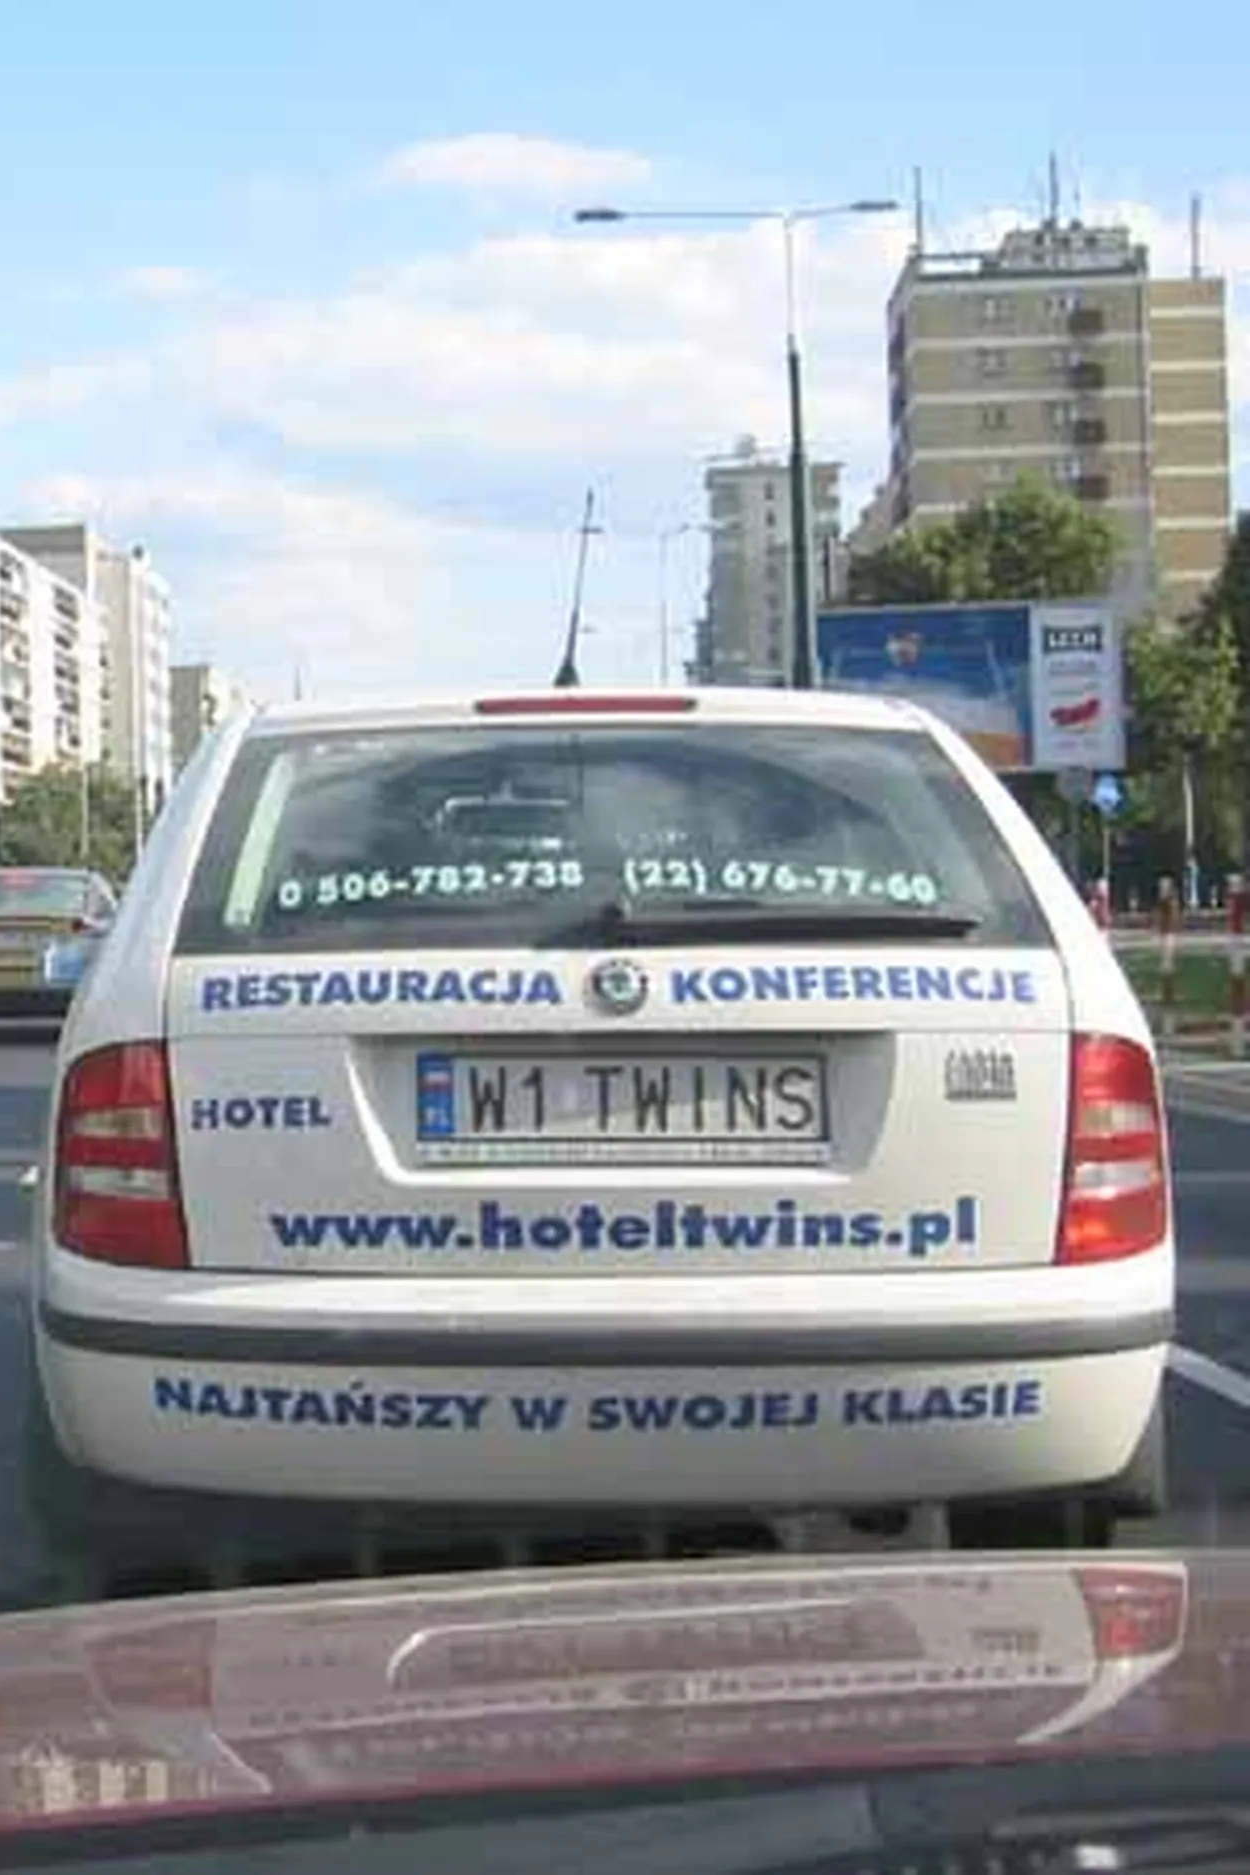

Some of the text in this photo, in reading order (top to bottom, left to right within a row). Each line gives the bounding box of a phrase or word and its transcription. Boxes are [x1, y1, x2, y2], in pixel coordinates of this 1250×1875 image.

[279, 880, 301, 908] 0
[623, 856, 707, 896] (22)
[202, 970, 562, 1011] RESTAURACJA
[670, 966, 1038, 1004] KONFERENCJE
[191, 1096, 332, 1130] HOTEL
[468, 1065, 814, 1133] W1 TWINS
[271, 1198, 977, 1256] www.hoteltwins.pl
[154, 1377, 1043, 1431] NAJTAŃSZY W SWOJEJ KLASIE
